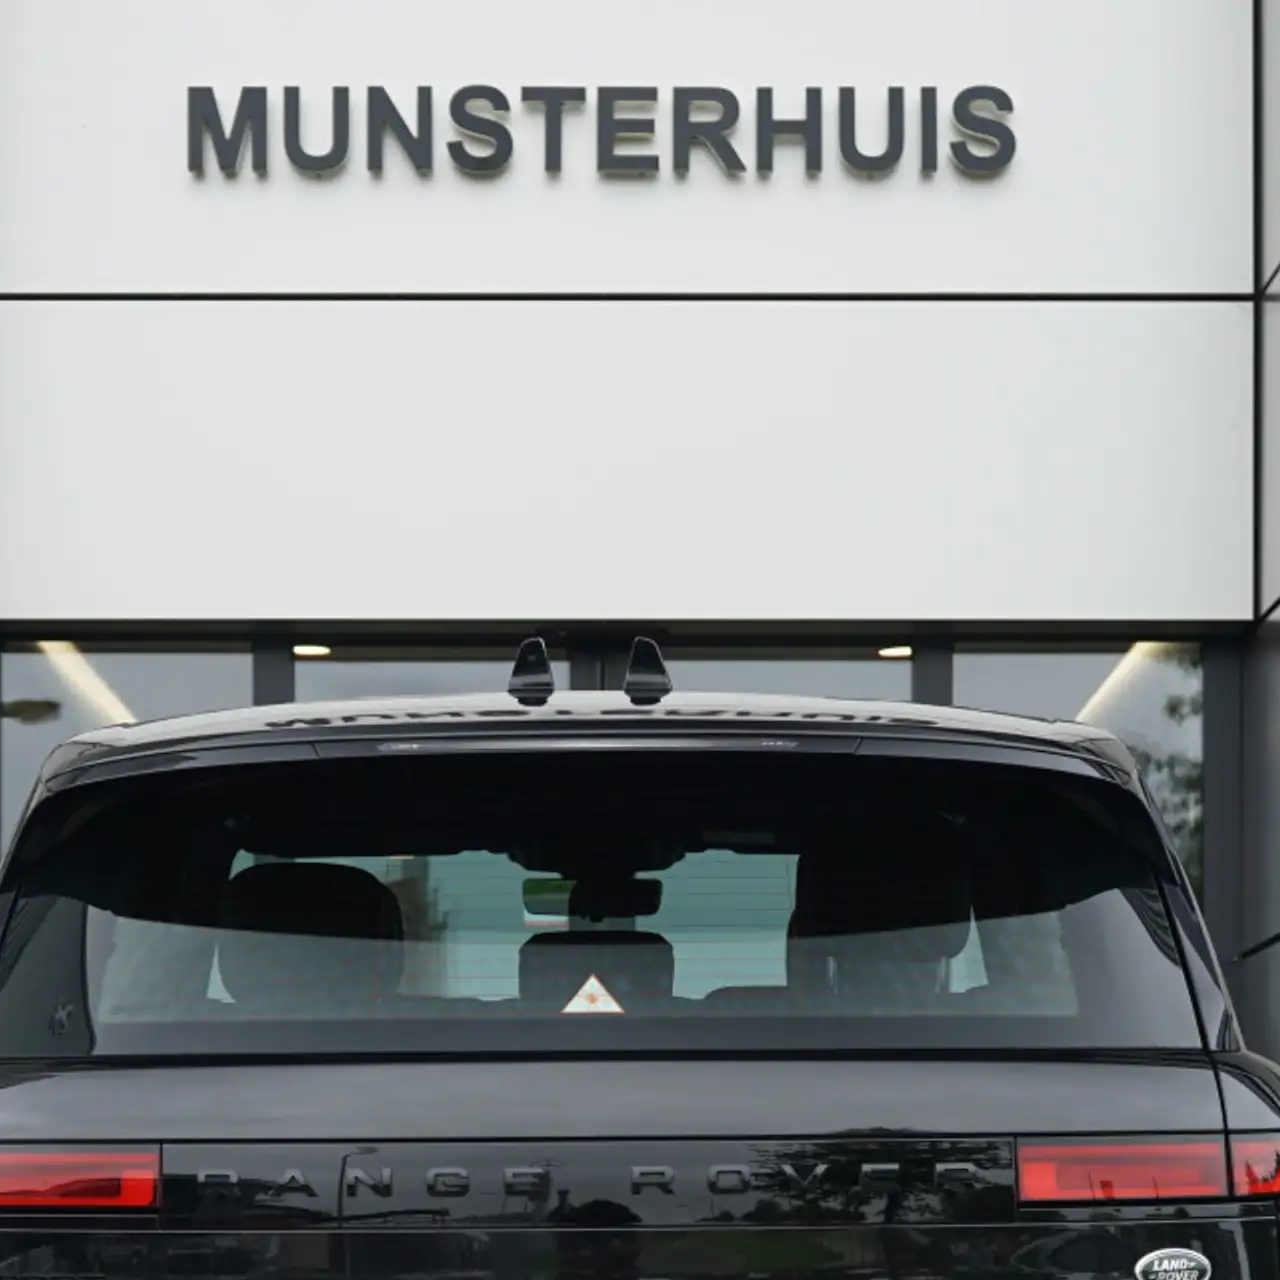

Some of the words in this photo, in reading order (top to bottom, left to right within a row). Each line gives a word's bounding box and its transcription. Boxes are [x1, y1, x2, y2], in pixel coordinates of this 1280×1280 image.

[187, 85, 1017, 177] MUNSTERHUIS
[196, 1166, 549, 1197] RANGE
[631, 1162, 980, 1196] ROVER
[1153, 1259, 1188, 1270] LAND
